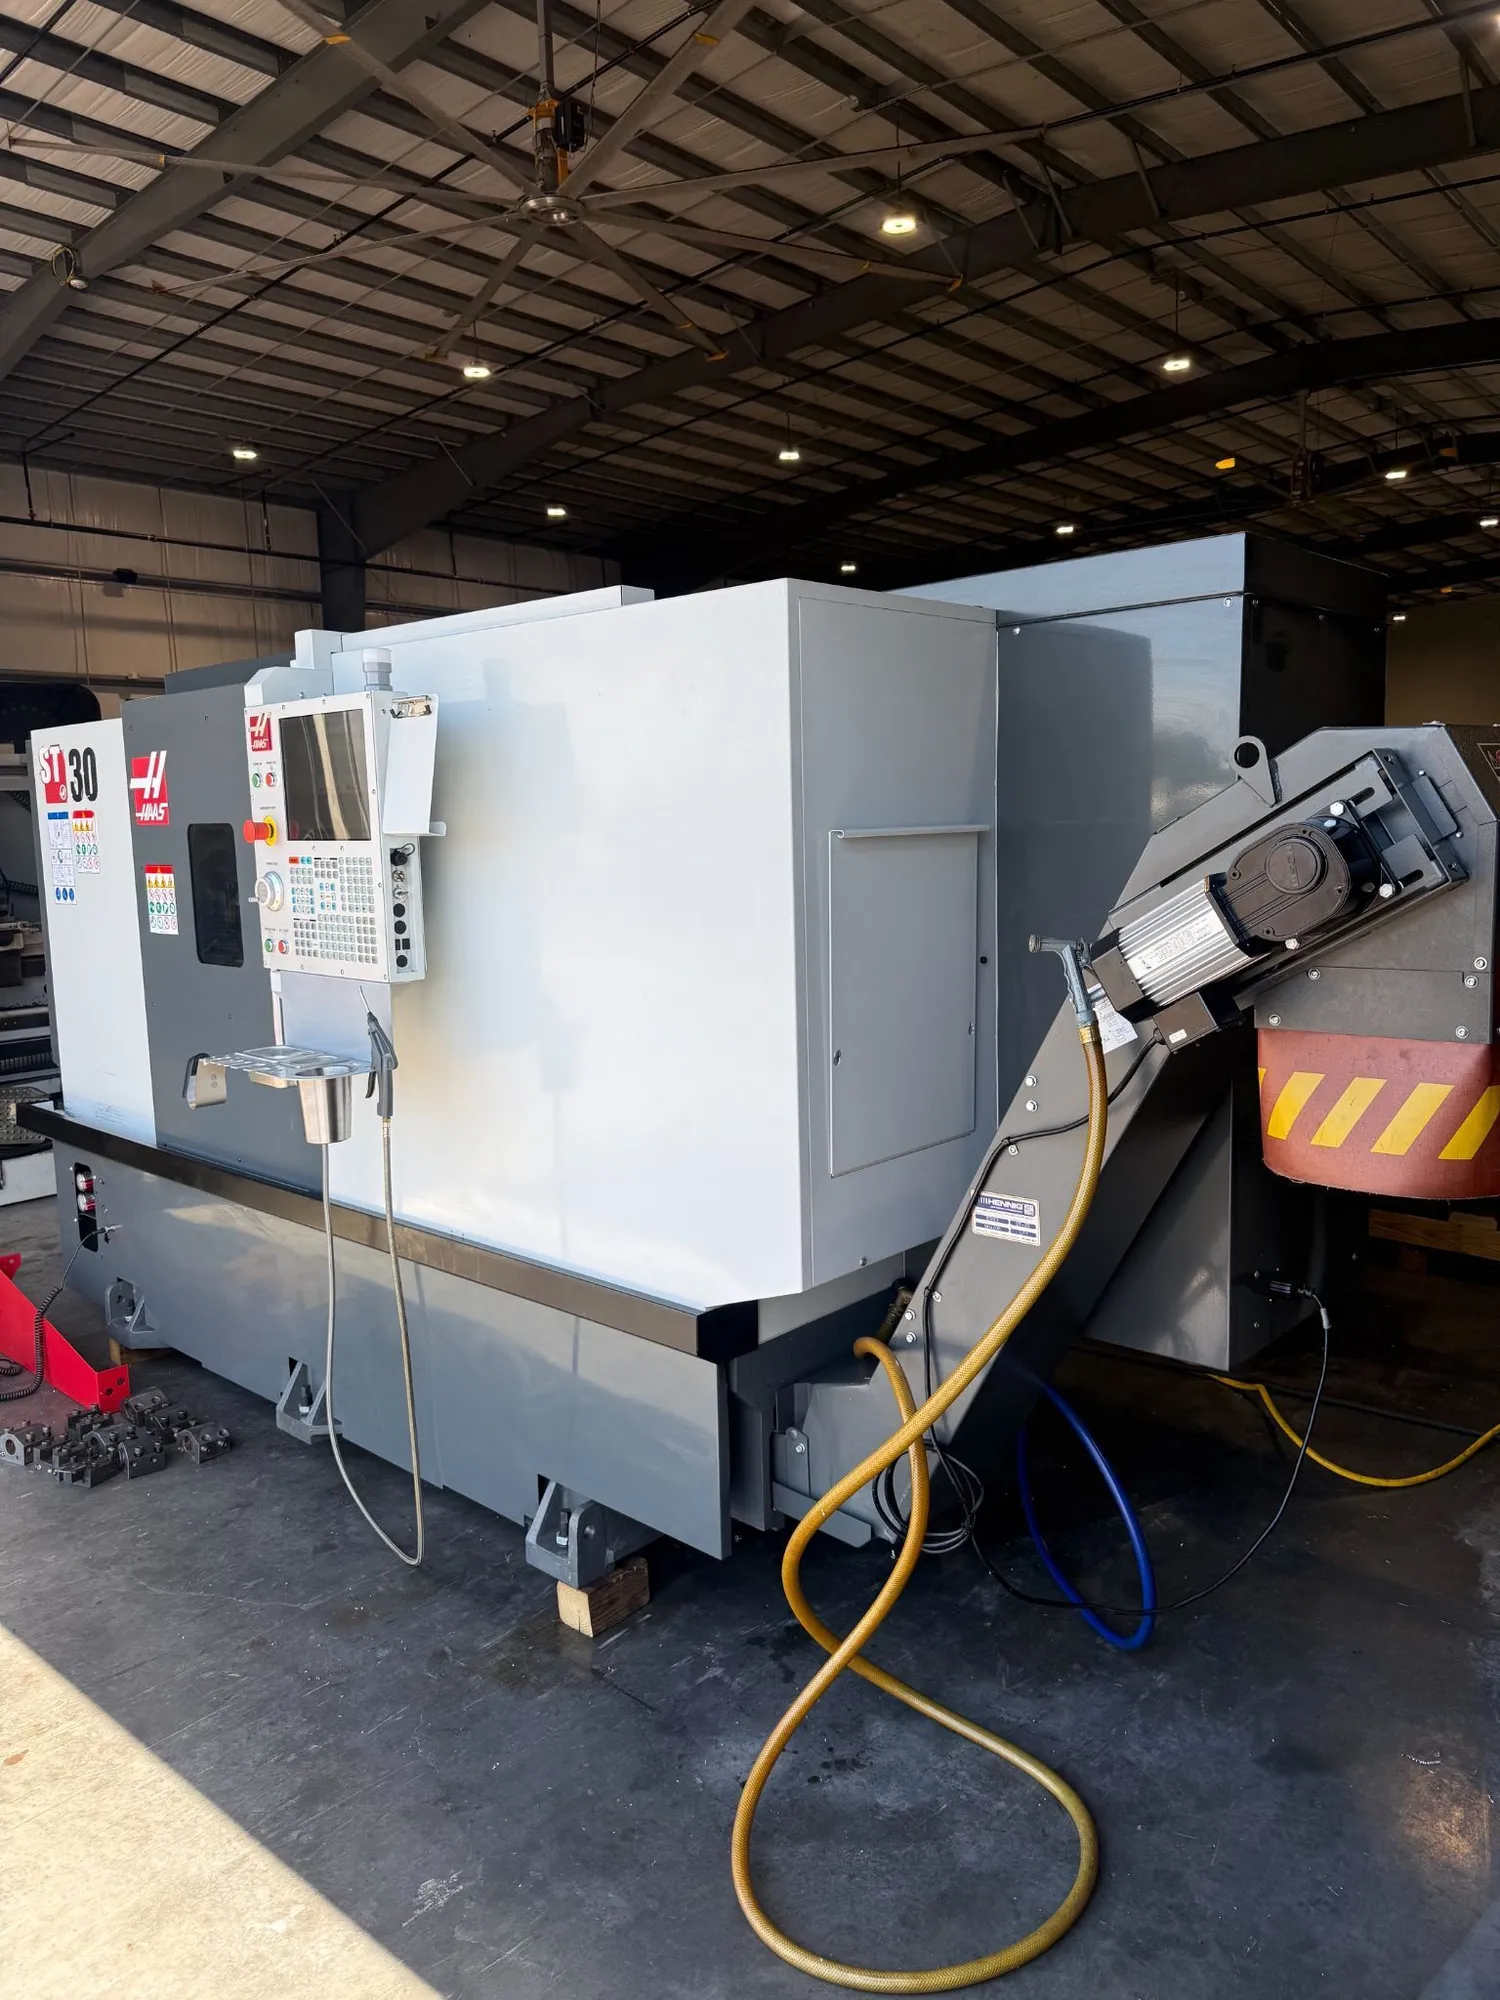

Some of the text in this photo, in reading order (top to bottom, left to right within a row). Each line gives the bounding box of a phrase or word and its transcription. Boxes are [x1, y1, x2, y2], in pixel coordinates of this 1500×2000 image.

[39, 744, 98, 802] ST 30
[136, 803, 168, 821] HAAS
[988, 1198, 1023, 1210] HENNIG
